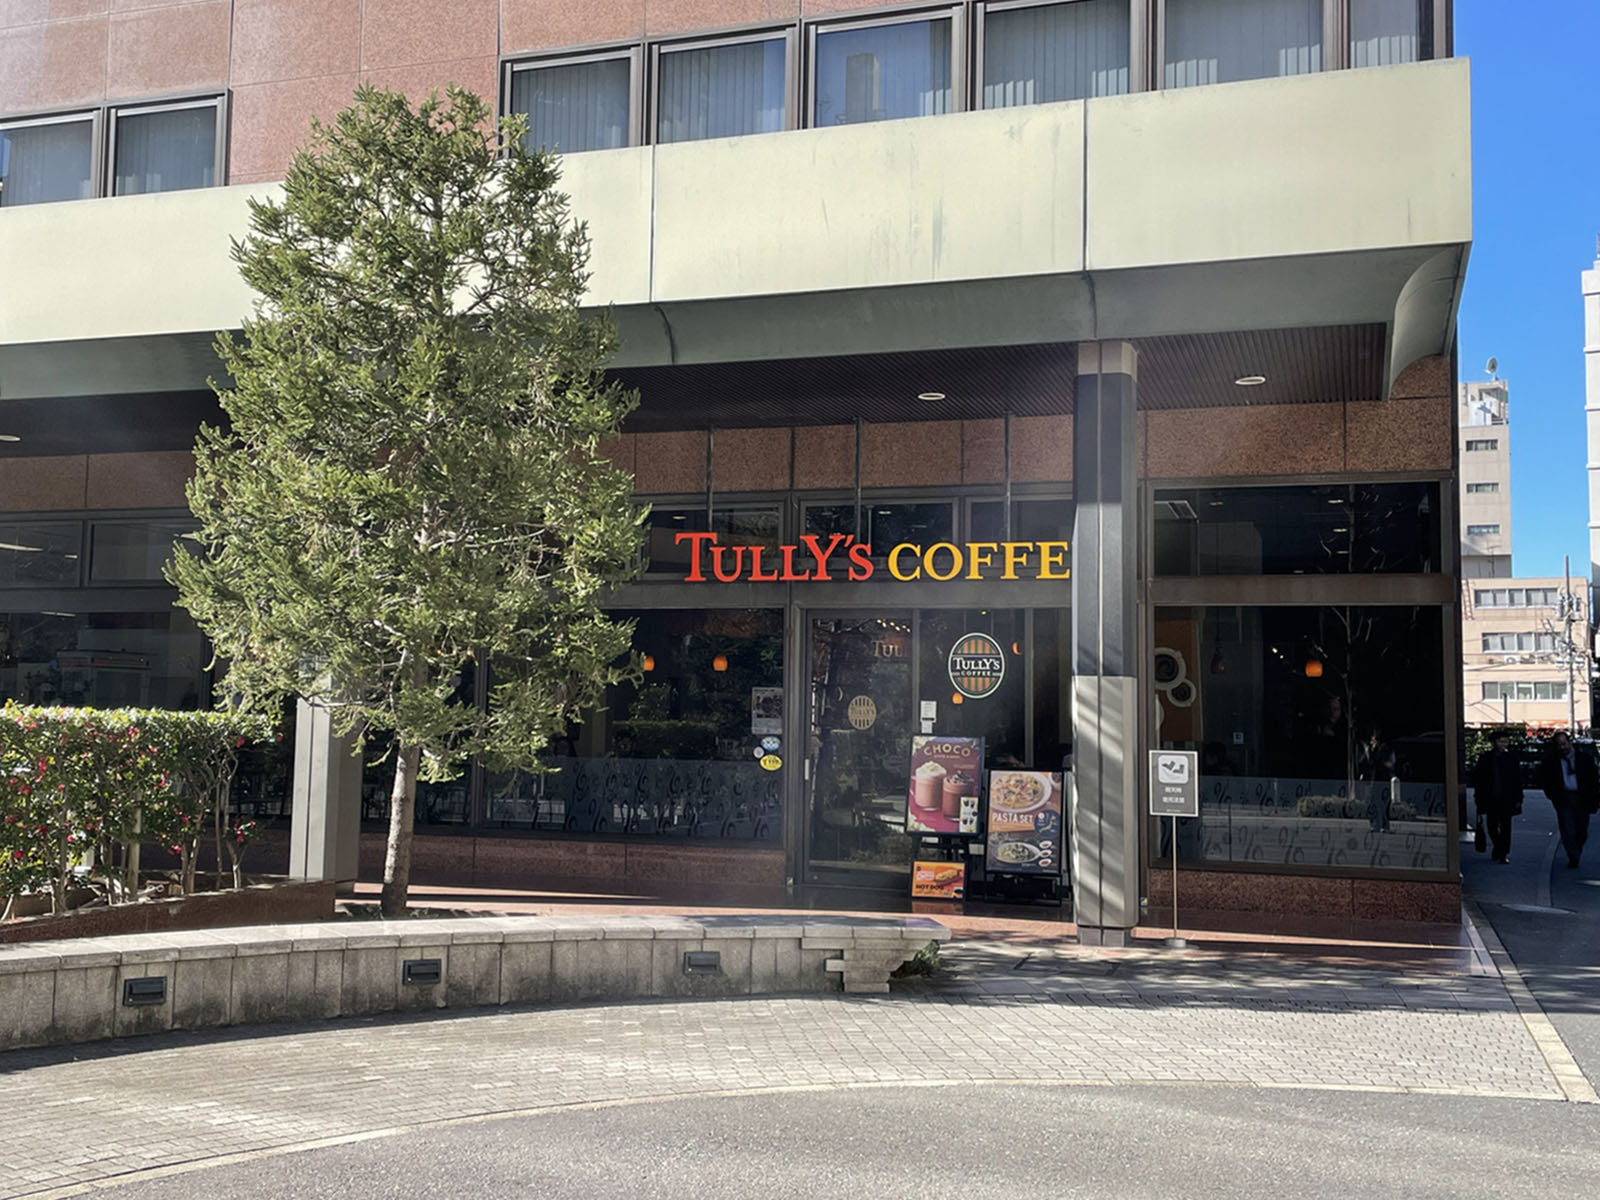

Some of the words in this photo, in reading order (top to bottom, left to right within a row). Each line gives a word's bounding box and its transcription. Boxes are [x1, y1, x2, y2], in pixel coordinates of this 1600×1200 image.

[675, 532, 874, 583] TULLY'S
[952, 657, 1001, 670] TULLY'S
[923, 743, 971, 757] CHOCO
[991, 812, 1018, 823] PASTA
[1019, 814, 1033, 824] SET
